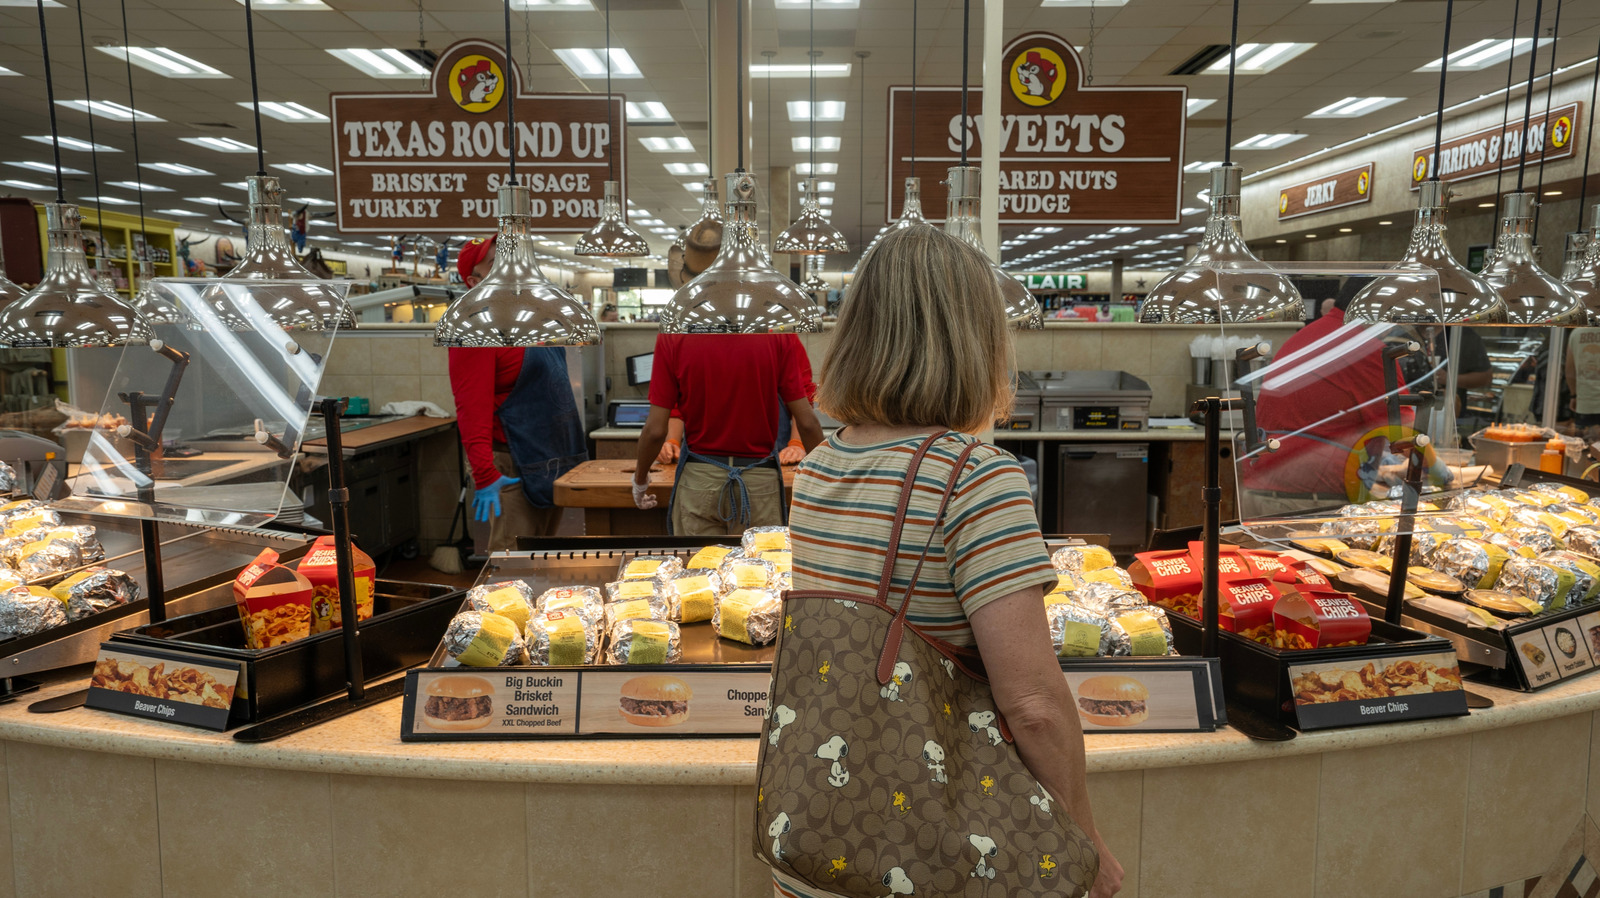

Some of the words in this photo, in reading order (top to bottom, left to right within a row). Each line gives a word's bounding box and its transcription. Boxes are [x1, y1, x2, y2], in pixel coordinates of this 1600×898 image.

[344, 121, 446, 157] TEXAS
[452, 121, 563, 158] ROUND
[570, 122, 610, 158] UP
[948, 114, 1125, 153] SWEETS
[1488, 135, 1500, 164] &
[372, 173, 467, 193] BRISKET
[487, 173, 590, 193] SAUSAGE
[998, 170, 1054, 190] ARED
[1059, 170, 1117, 190] NUTS
[1304, 179, 1338, 208] JERKY
[349, 199, 442, 218] TURKEY
[461, 199, 547, 218] PUD
[998, 194, 1071, 214] FUDGE
[307, 556, 337, 566] CHIPS
[1151, 557, 1186, 568] BEAVER
[1218, 563, 1241, 573] HIPS
[1156, 563, 1192, 577] CHIPS
[1228, 582, 1267, 595] BEAVER
[1234, 589, 1274, 606] CHIPS
[1314, 597, 1353, 608] BEAVER
[1320, 605, 1360, 619] CHIPS
[505, 676, 523, 690] Big
[525, 676, 563, 688] Buckin
[514, 690, 553, 702] Brisket
[727, 689, 767, 703] Choppe
[134, 700, 157, 713] Beaver
[157, 703, 176, 717] Chips
[505, 704, 559, 716] Sandwich
[743, 705, 765, 717] San
[1360, 703, 1386, 715] Beaver
[1387, 702, 1409, 714] Chips
[502, 719, 515, 727] XXL
[516, 719, 545, 728] Chopped
[547, 719, 562, 727] Beef
